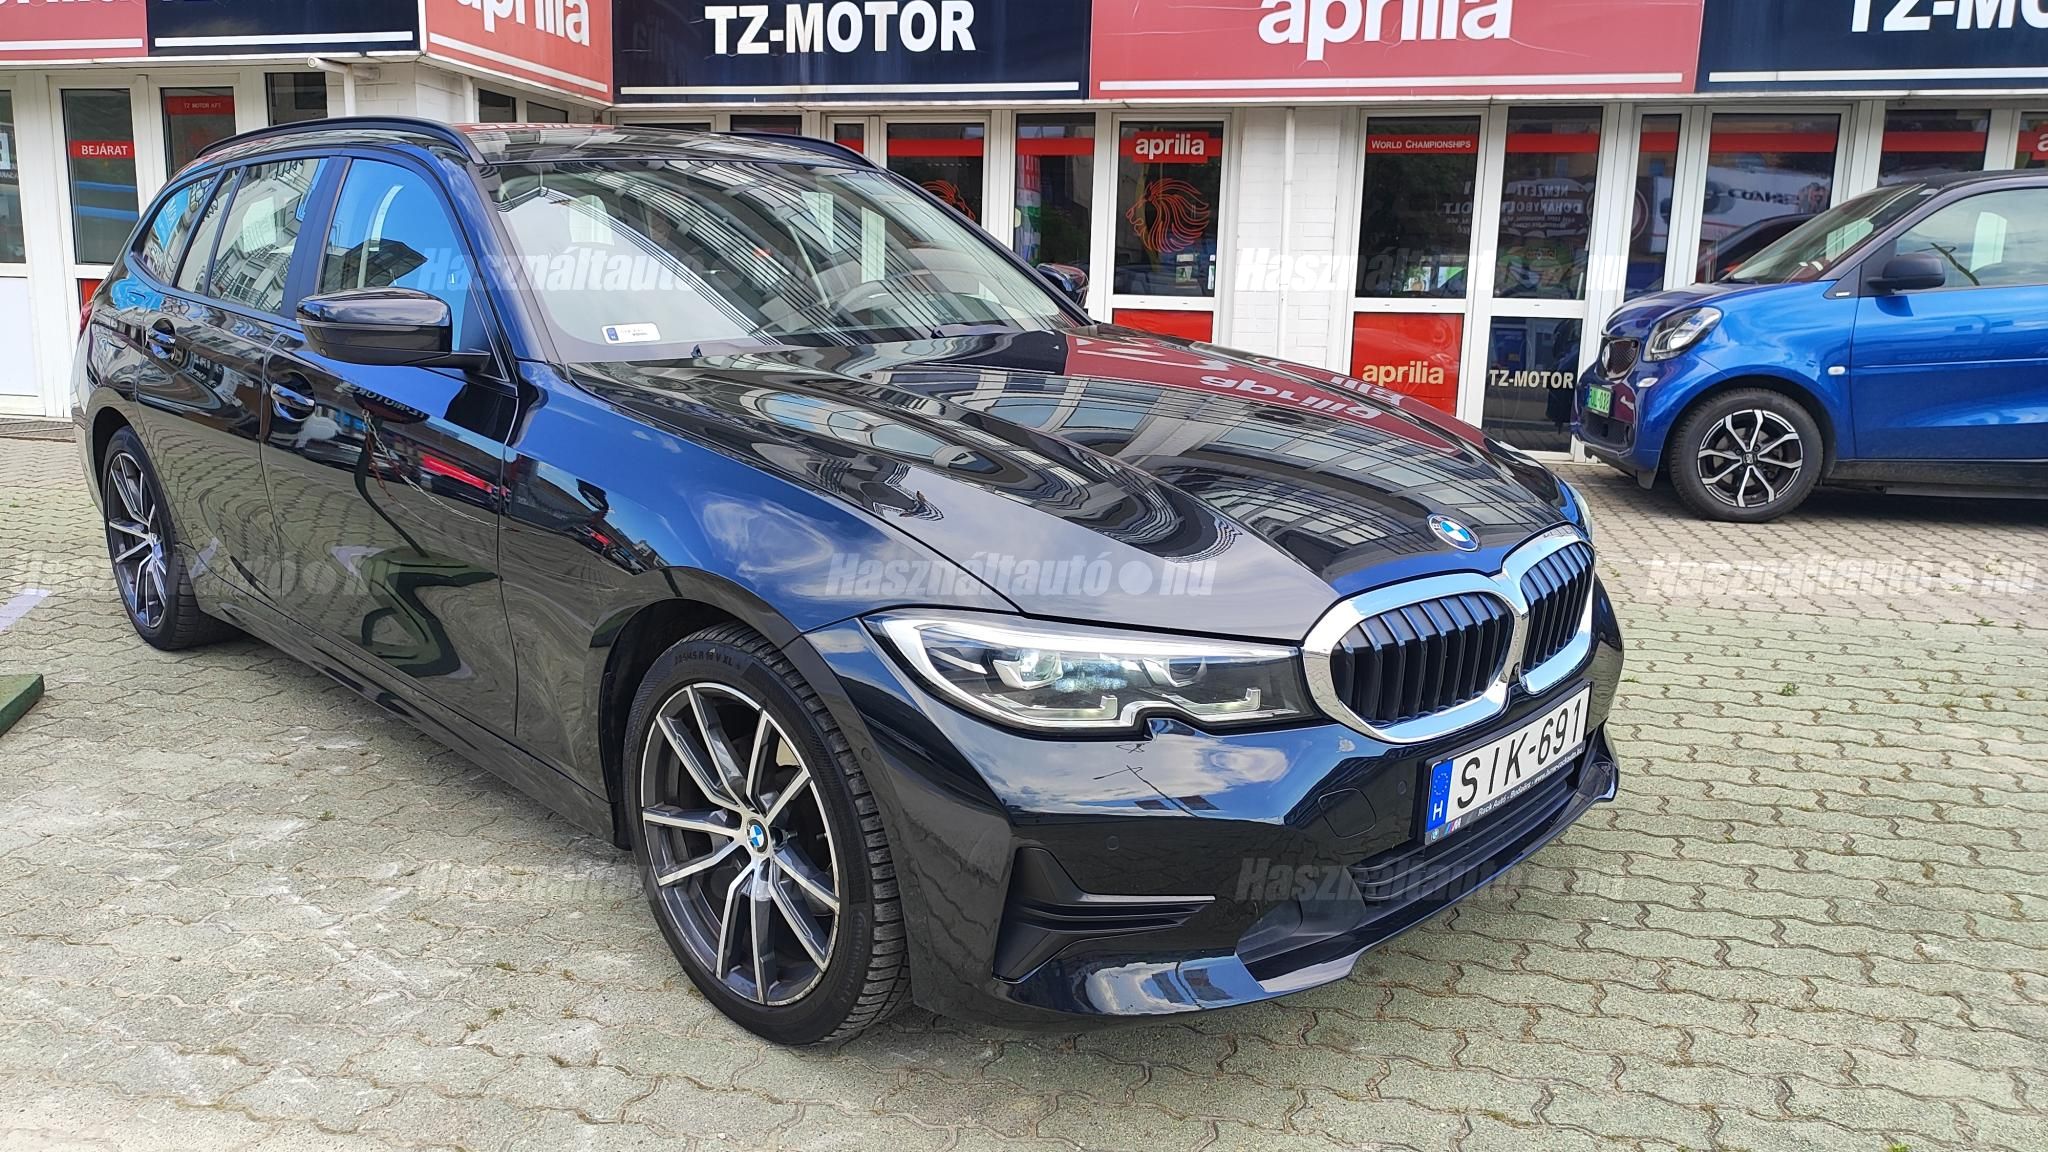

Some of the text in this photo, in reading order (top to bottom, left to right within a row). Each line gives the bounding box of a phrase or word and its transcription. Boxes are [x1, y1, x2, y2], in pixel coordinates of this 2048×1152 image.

[455, 0, 590, 47] prilia
[704, 0, 977, 54] TZ-MOTOR
[81, 141, 128, 156] BEJÁRAT
[1135, 133, 1205, 159] aprilia
[1371, 139, 1472, 149] WORLD CHAMPIONSHIPS
[1362, 360, 1444, 386] aprilia
[1489, 369, 1574, 389] TZ-MOTOR
[1457, 697, 1583, 810] SIK-691
[1432, 799, 1444, 822] H
